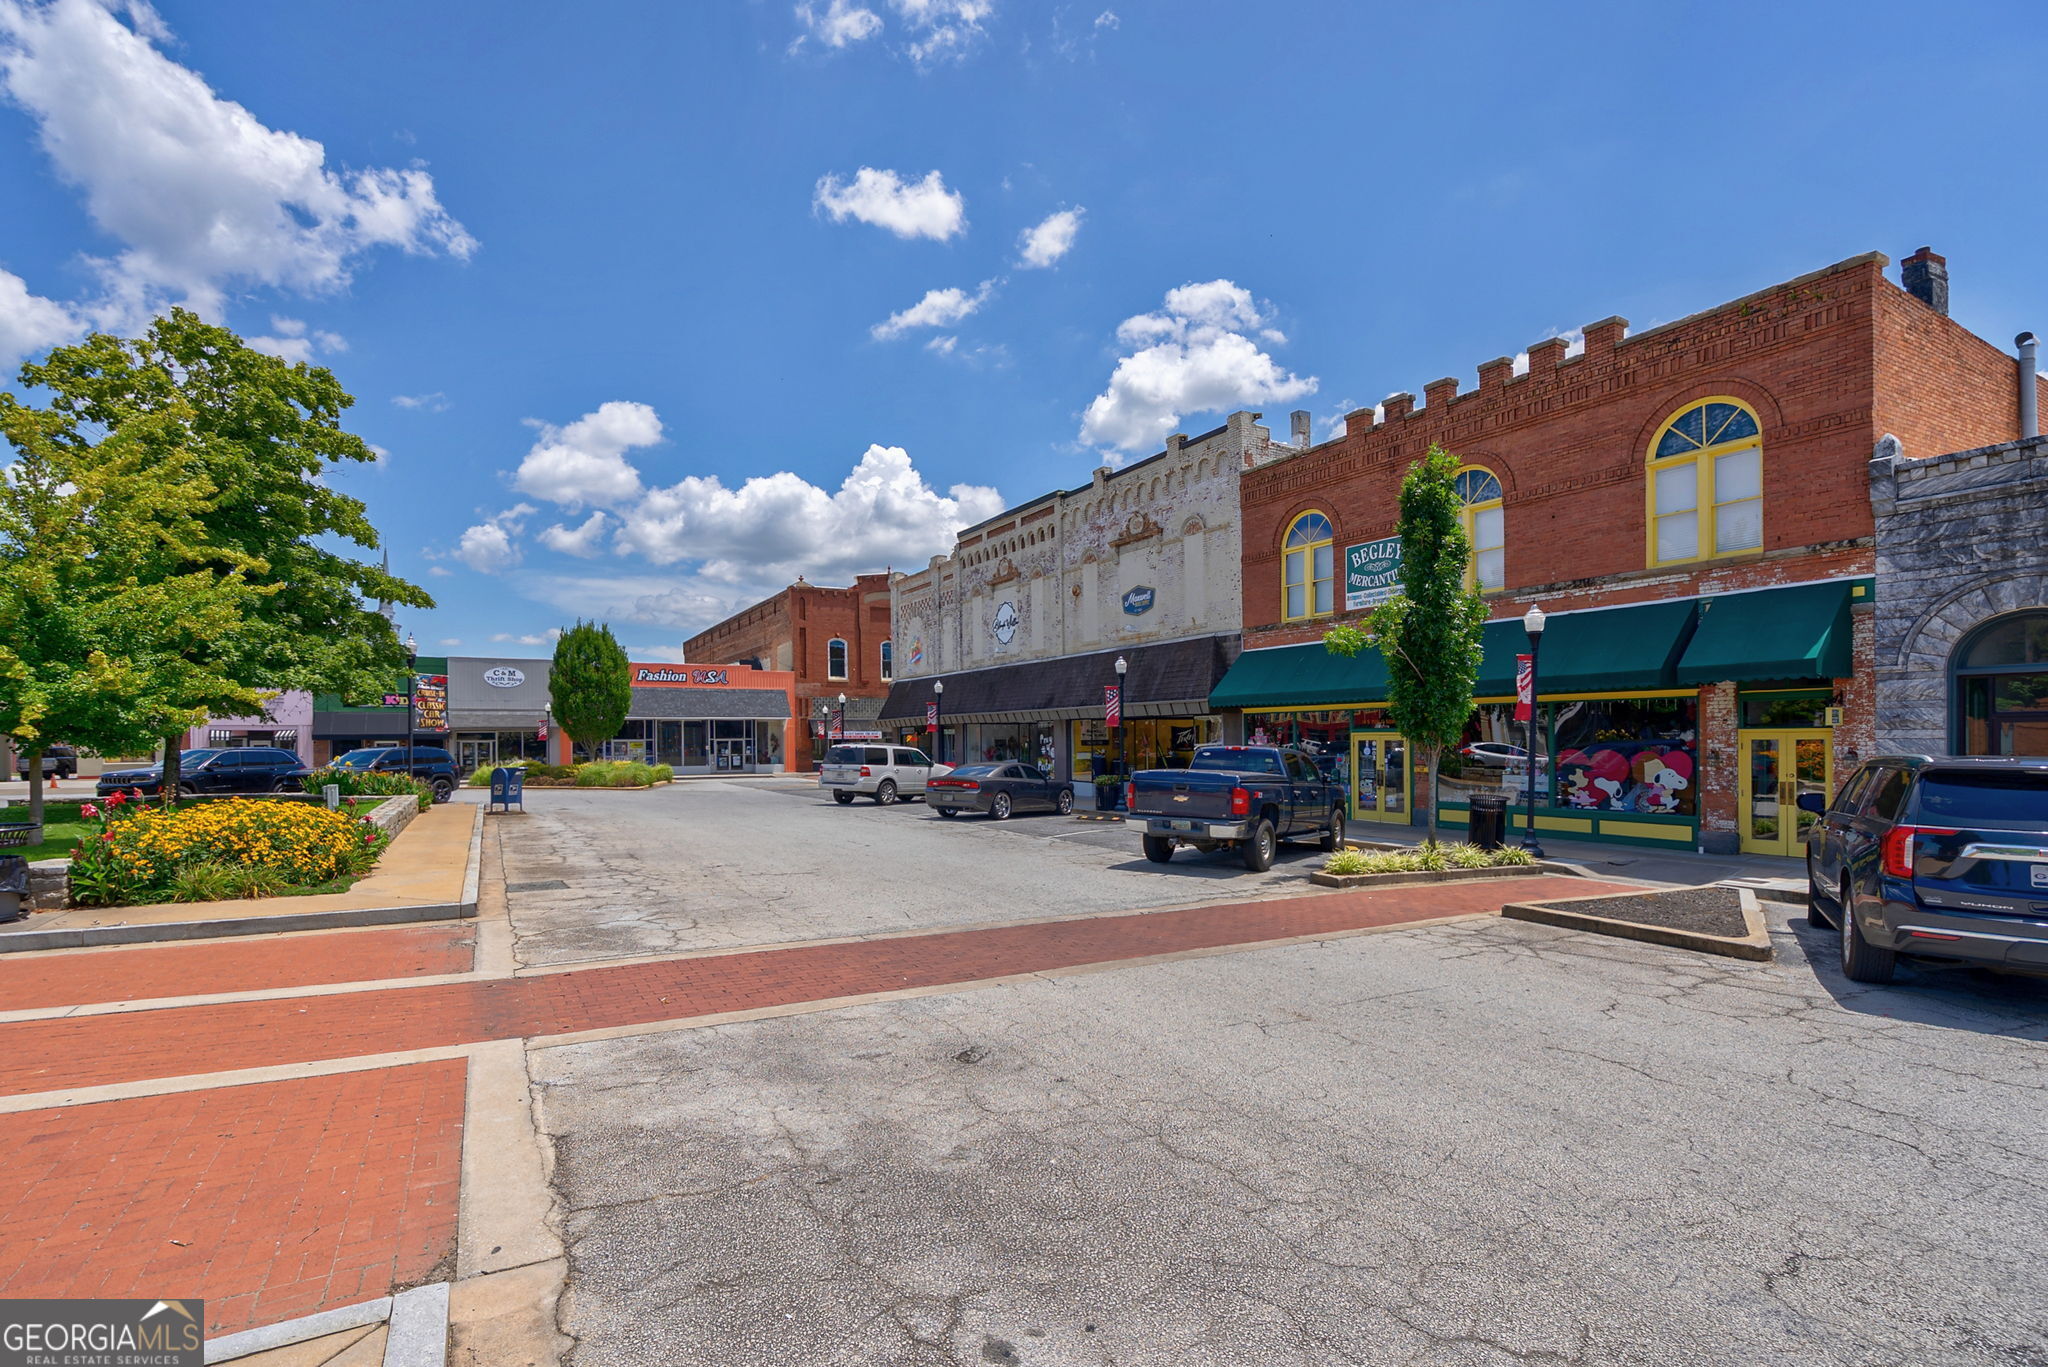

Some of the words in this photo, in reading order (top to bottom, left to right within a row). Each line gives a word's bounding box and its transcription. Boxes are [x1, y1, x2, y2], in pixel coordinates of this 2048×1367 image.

[637, 669, 687, 682] Fashion
[692, 670, 729, 684] USA
[417, 700, 446, 710] CLASSIC
[423, 710, 440, 718] CAR
[420, 719, 445, 727] SHOW
